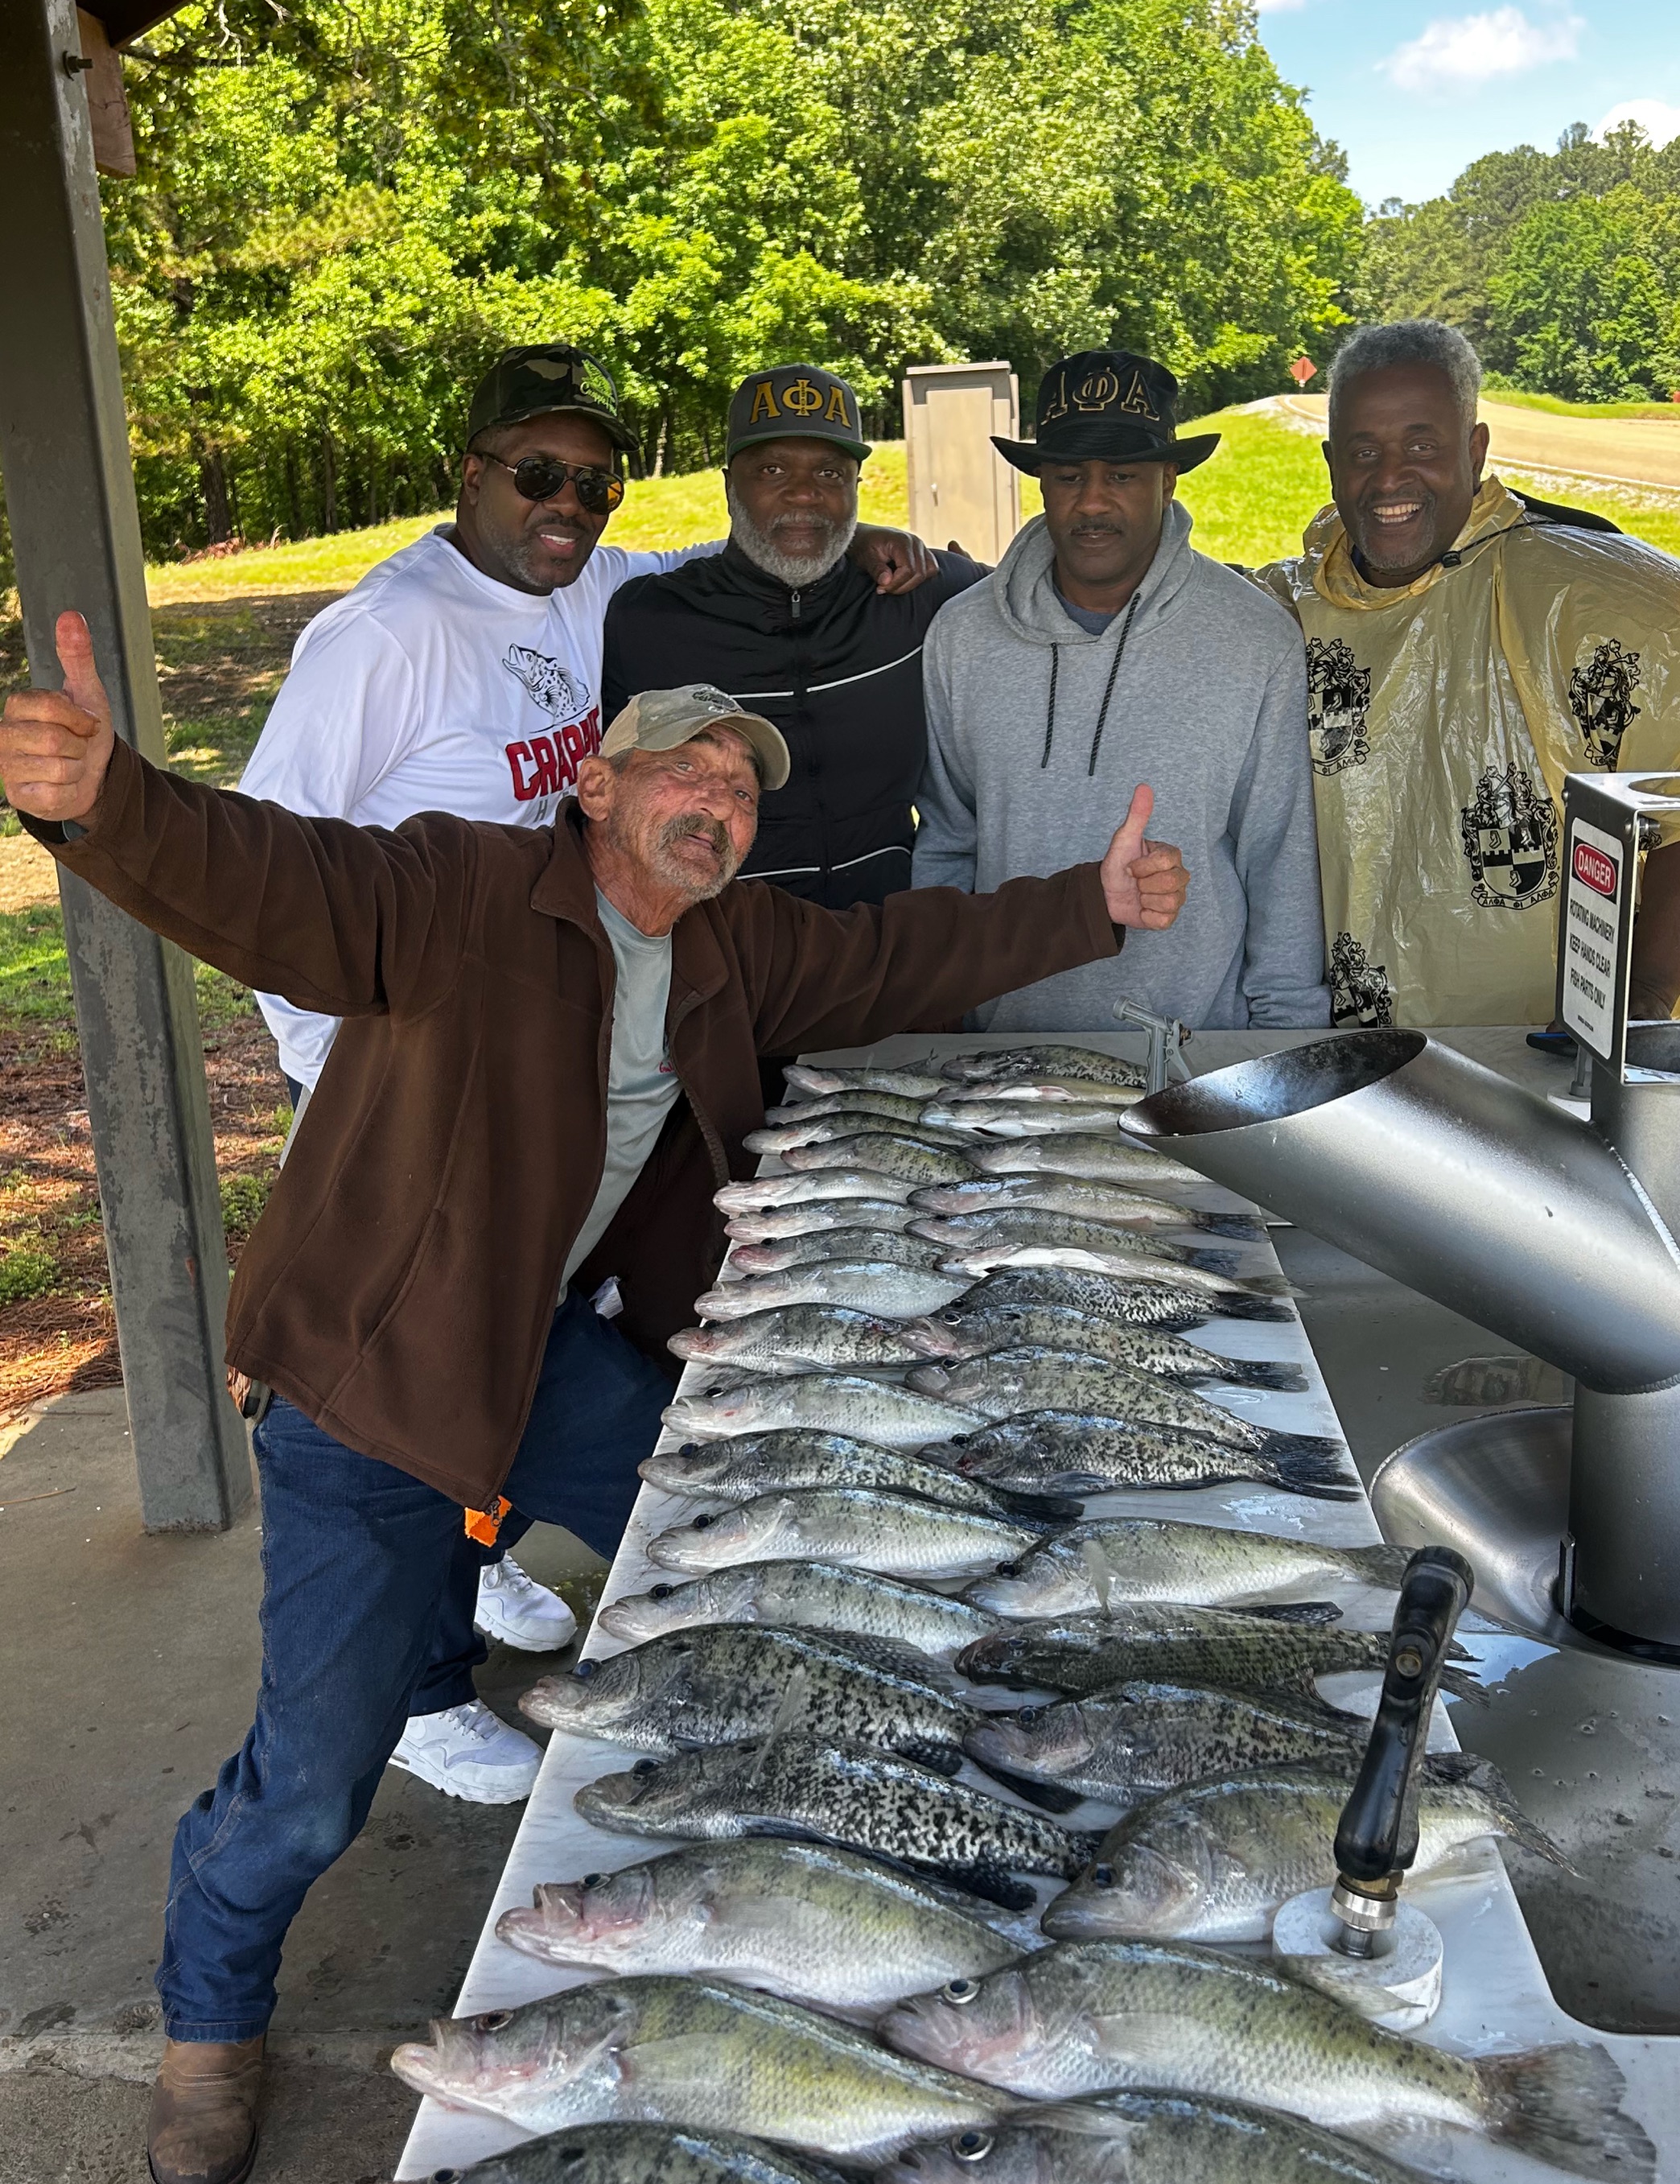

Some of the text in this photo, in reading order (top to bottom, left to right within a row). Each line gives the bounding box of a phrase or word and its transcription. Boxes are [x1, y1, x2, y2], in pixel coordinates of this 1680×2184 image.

[1579, 850, 1612, 888] DANGER
[1570, 898, 1615, 944] ROTATING MACHINERY
[1570, 932, 1611, 978] KEEP HANDS CLEAR
[1570, 967, 1606, 1010] FISH PARTS ONLY
